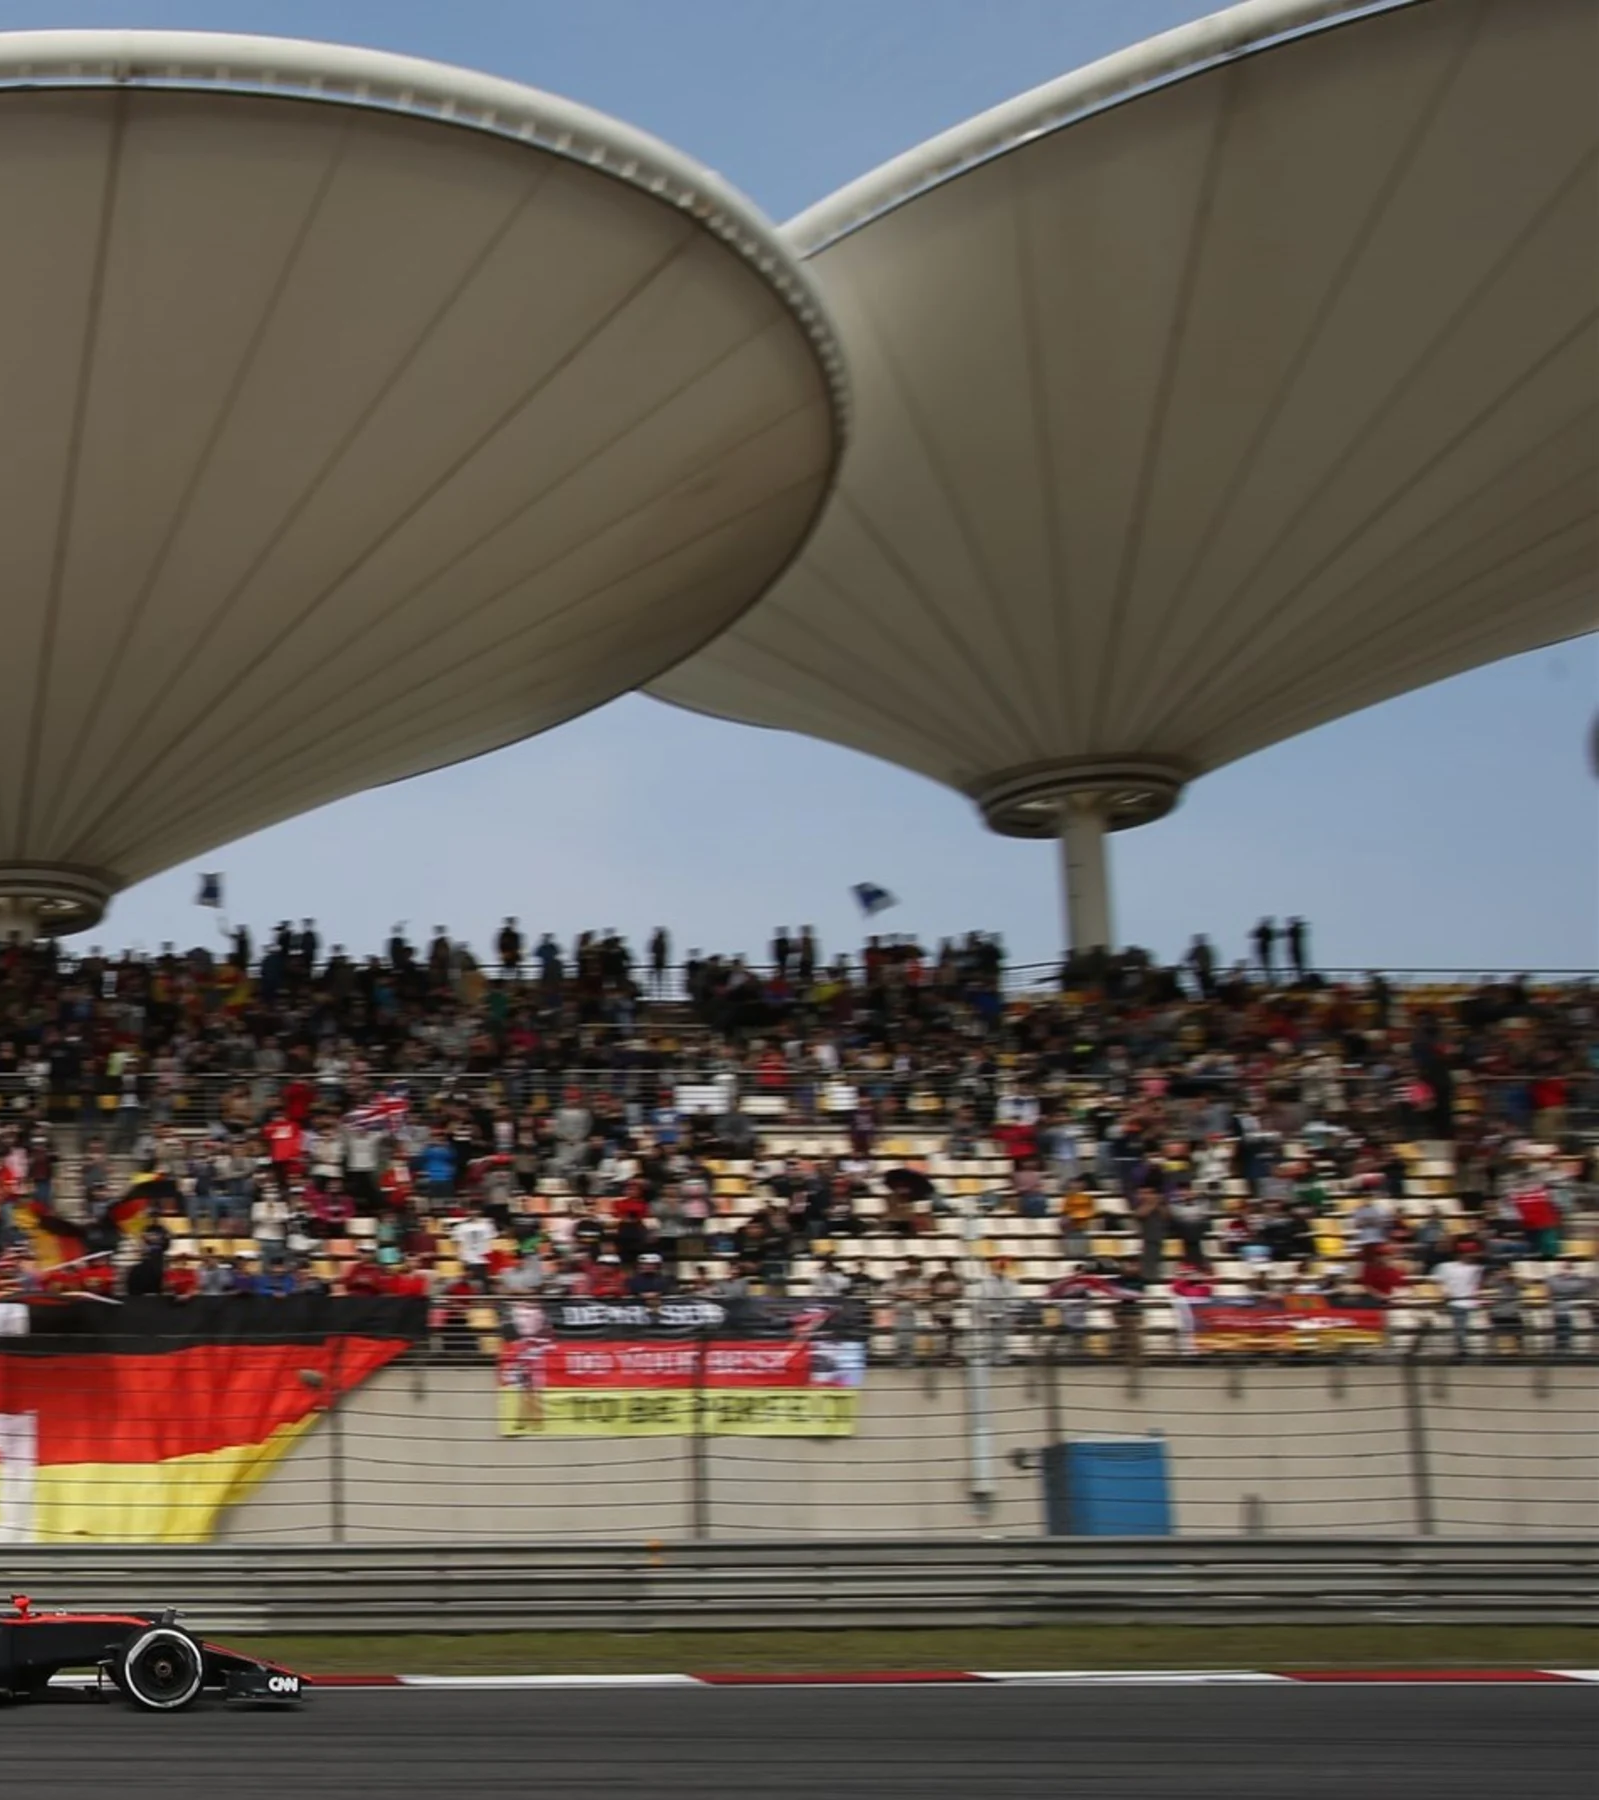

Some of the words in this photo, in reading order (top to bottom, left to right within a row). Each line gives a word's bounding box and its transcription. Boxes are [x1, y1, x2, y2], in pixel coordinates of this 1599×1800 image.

[572, 1396, 619, 1424] TO
[628, 1396, 677, 1424] BE
[268, 1676, 299, 1692] CNN
